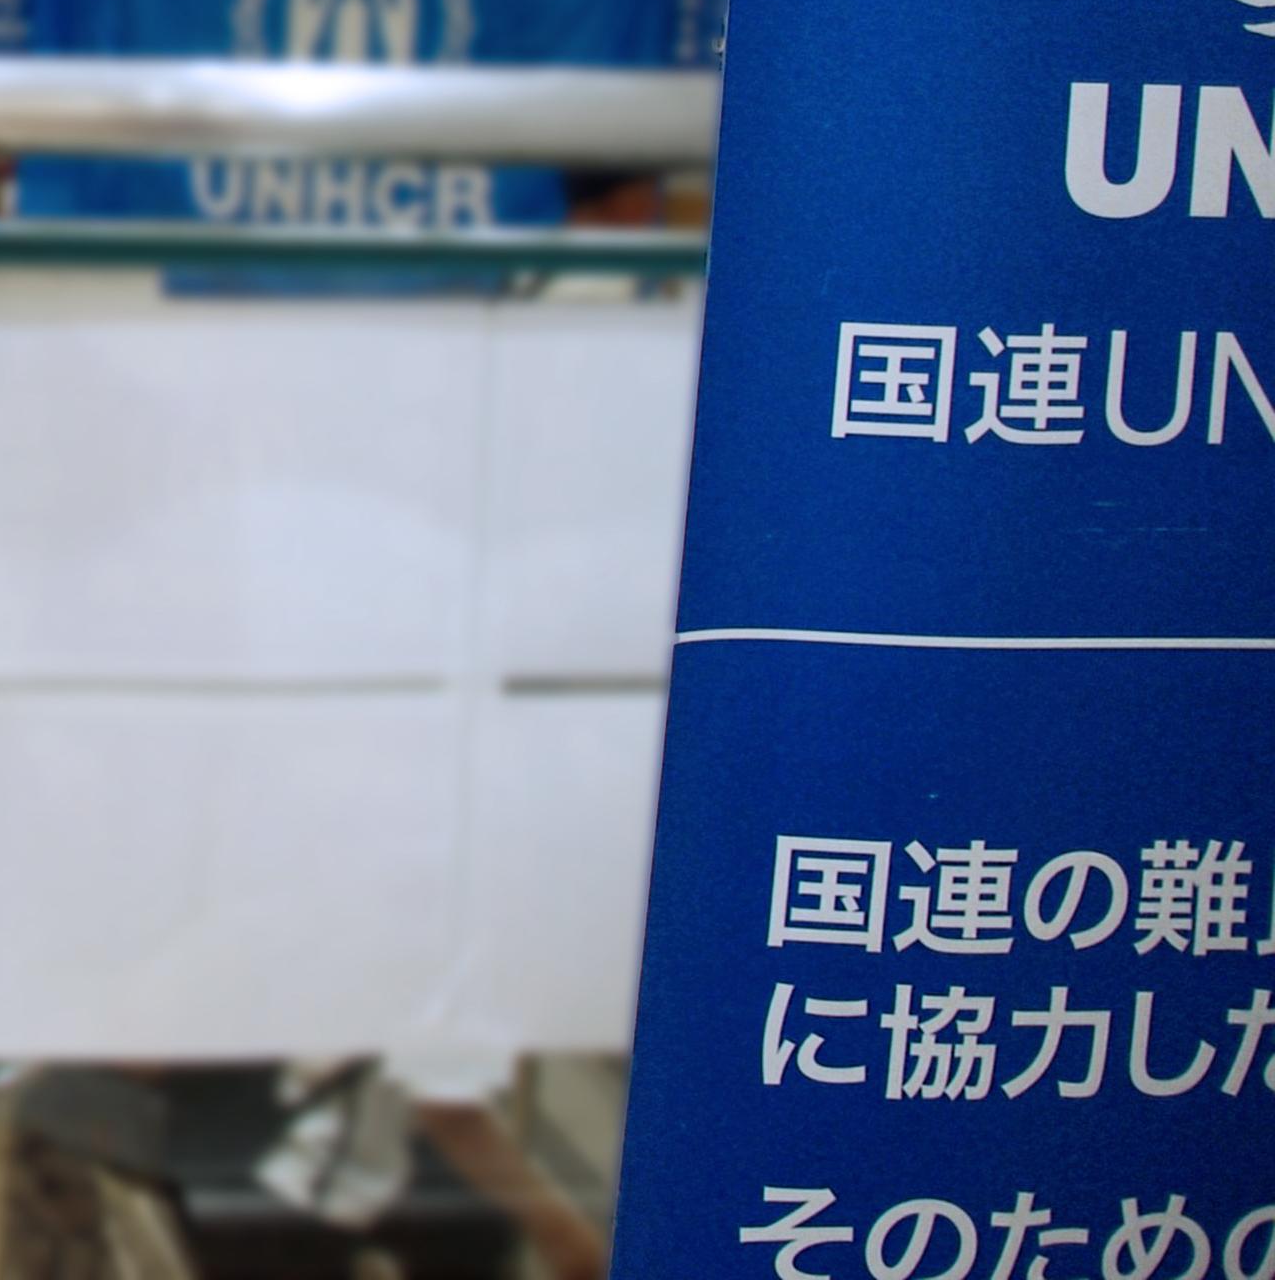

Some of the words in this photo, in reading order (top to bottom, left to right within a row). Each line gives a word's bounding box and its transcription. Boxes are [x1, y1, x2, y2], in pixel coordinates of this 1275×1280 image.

[190, 158, 494, 230] UNHCR
[767, 835, 1275, 955] 国連の難
